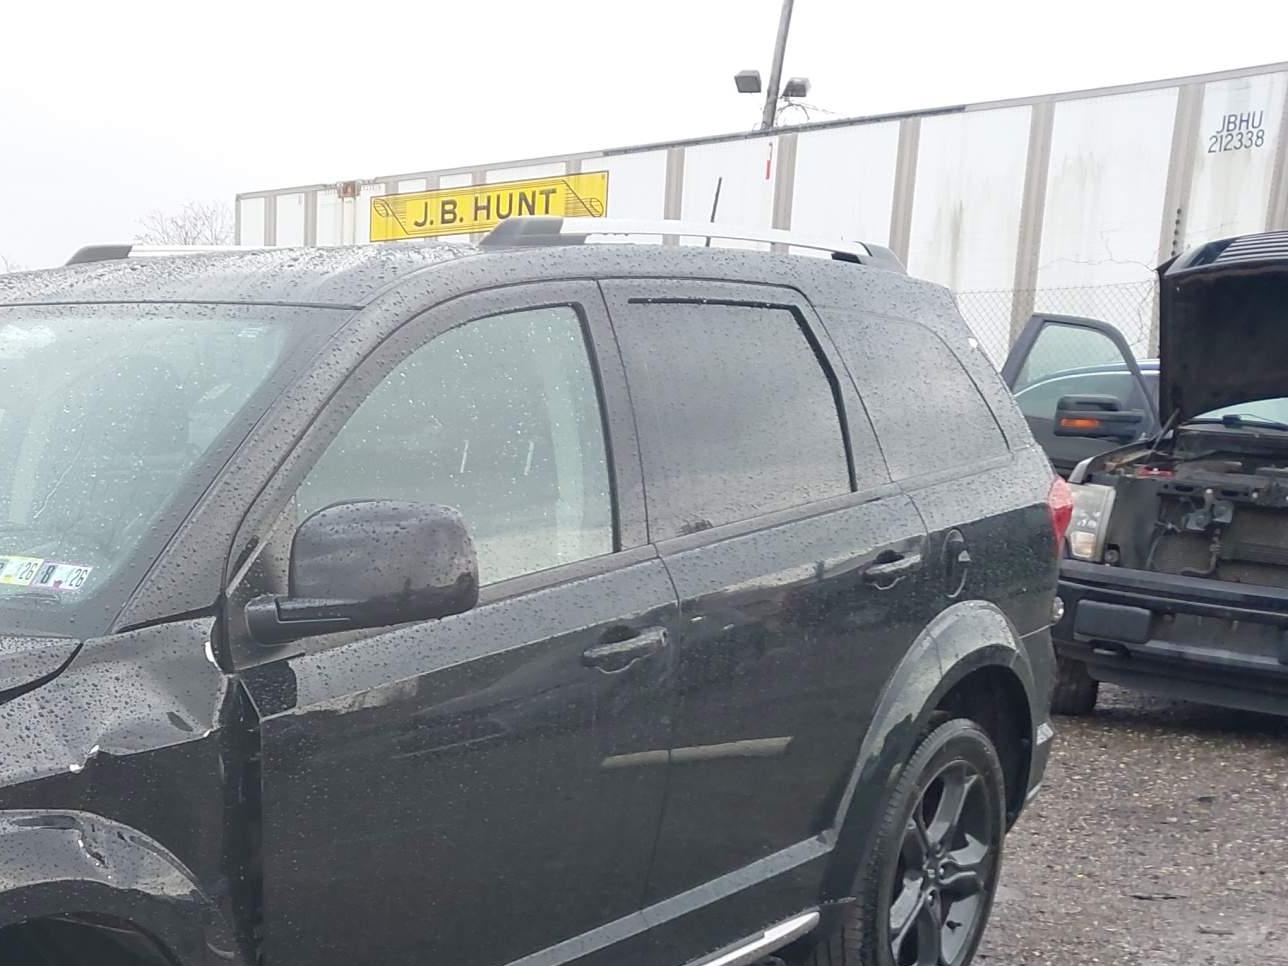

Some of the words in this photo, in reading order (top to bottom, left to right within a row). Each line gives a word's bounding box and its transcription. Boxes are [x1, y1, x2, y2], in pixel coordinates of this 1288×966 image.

[1216, 110, 1264, 134] JBHU
[1208, 129, 1265, 153] 212338
[473, 188, 557, 222] HUNT
[18, 562, 39, 580] 26
[40, 565, 56, 584] 8
[69, 569, 88, 587] 26
